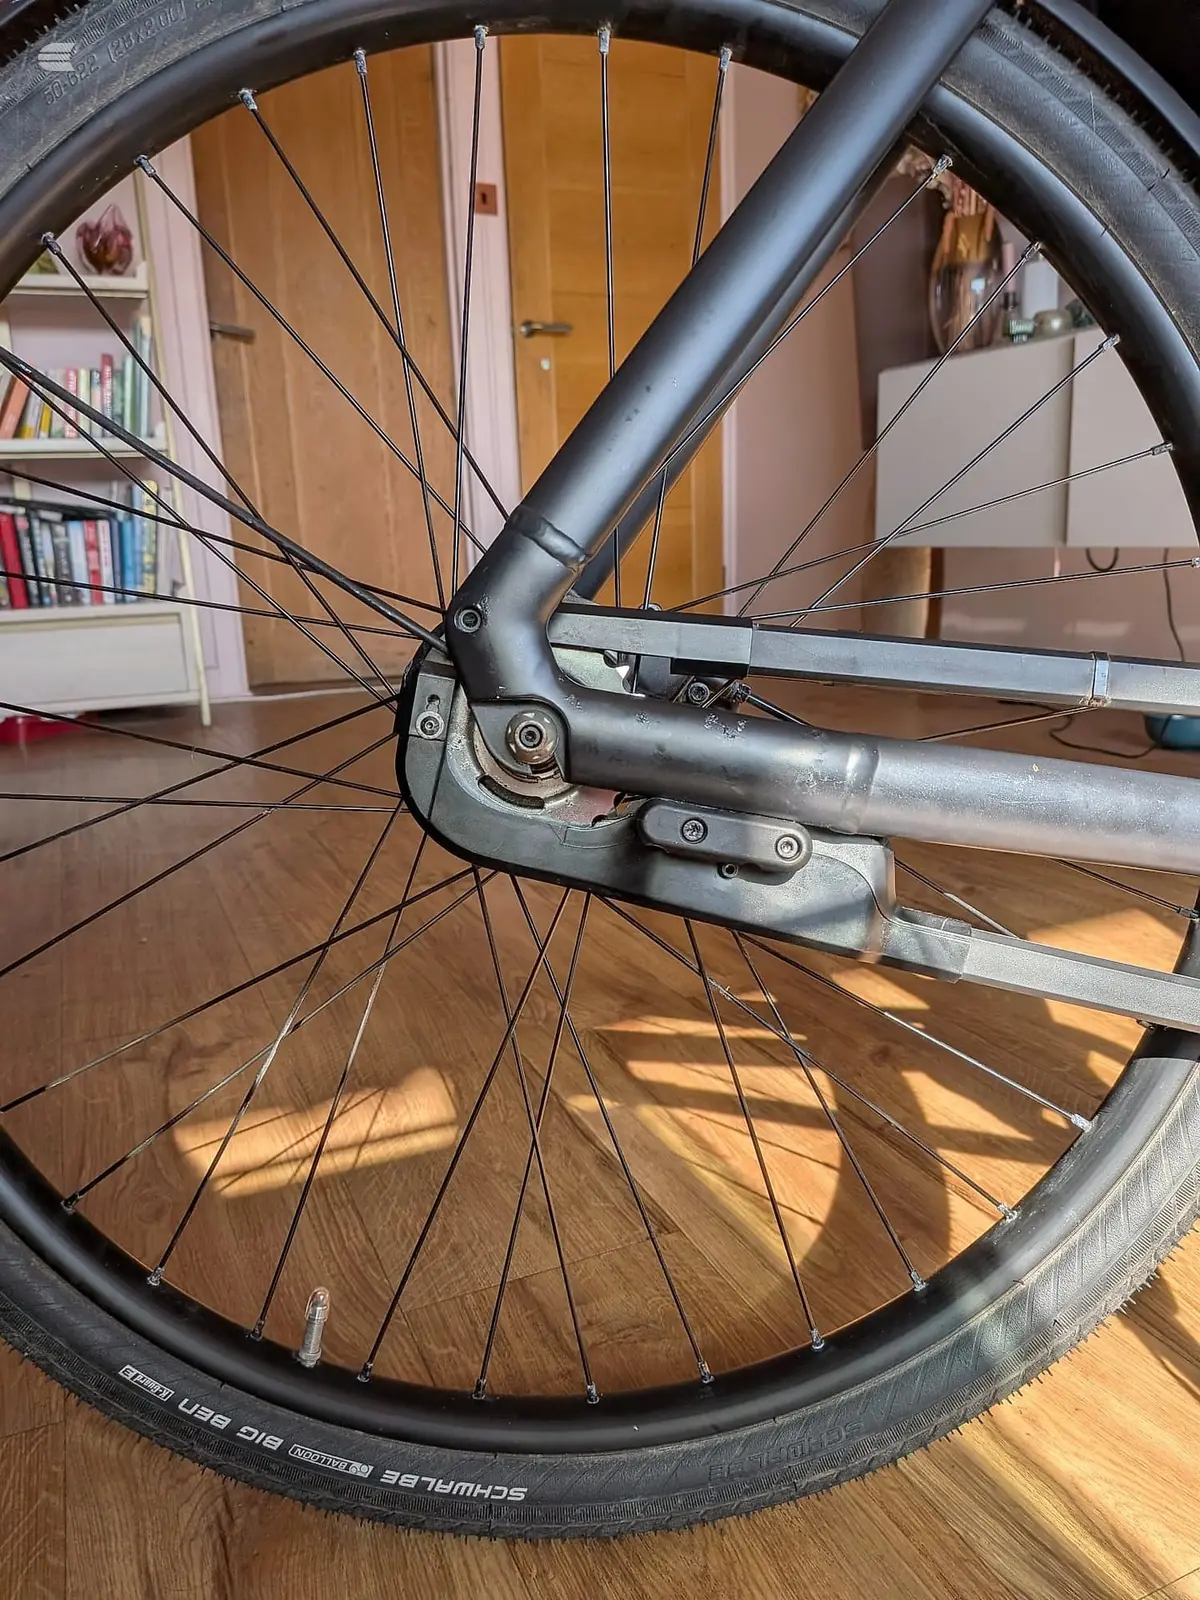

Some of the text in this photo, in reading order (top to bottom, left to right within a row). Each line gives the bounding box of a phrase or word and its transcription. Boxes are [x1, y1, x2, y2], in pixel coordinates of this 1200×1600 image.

[177, 1397, 284, 1451] BIG BEN
[292, 1447, 348, 1470] BALLOON
[379, 1469, 528, 1501] SCHWALBE
